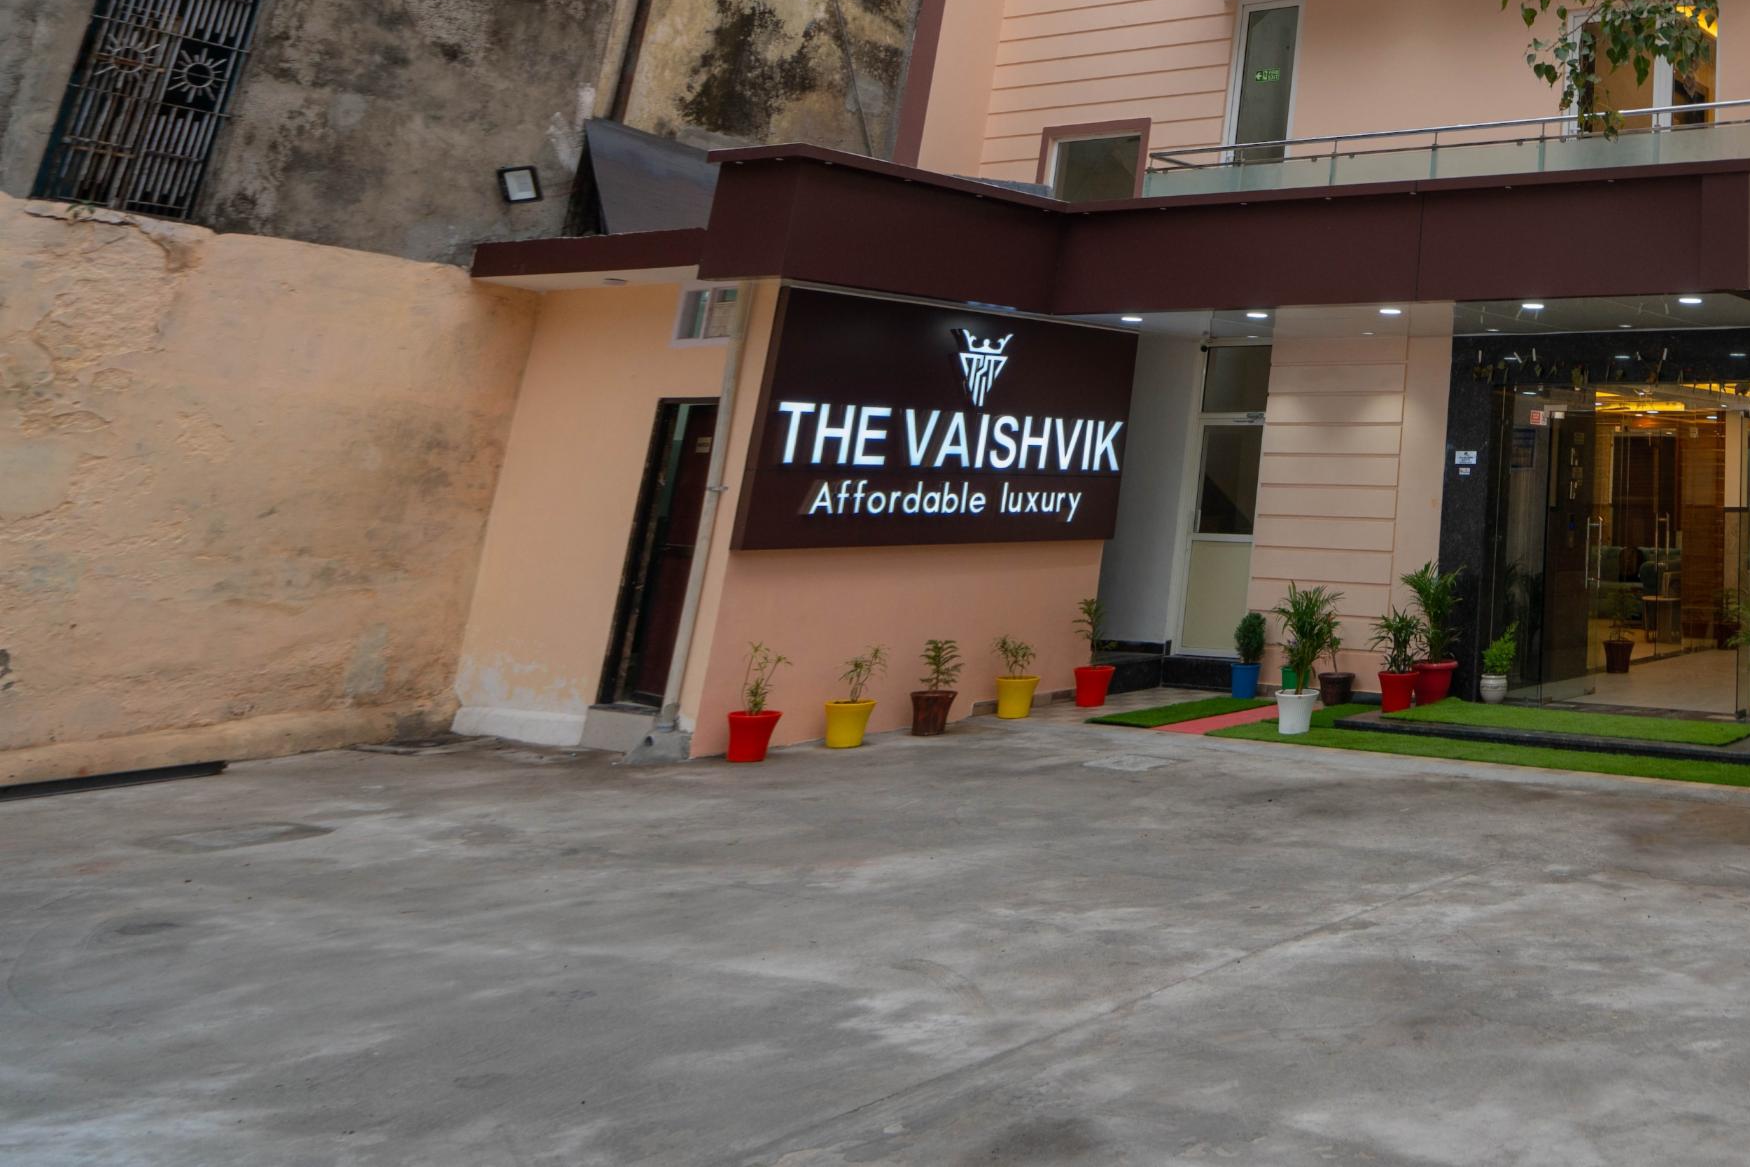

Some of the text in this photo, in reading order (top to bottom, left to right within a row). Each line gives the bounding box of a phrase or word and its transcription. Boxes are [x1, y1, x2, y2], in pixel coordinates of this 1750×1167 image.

[779, 401, 1123, 471] THE VAISHVIK
[809, 480, 1081, 522] Affordable luxury
